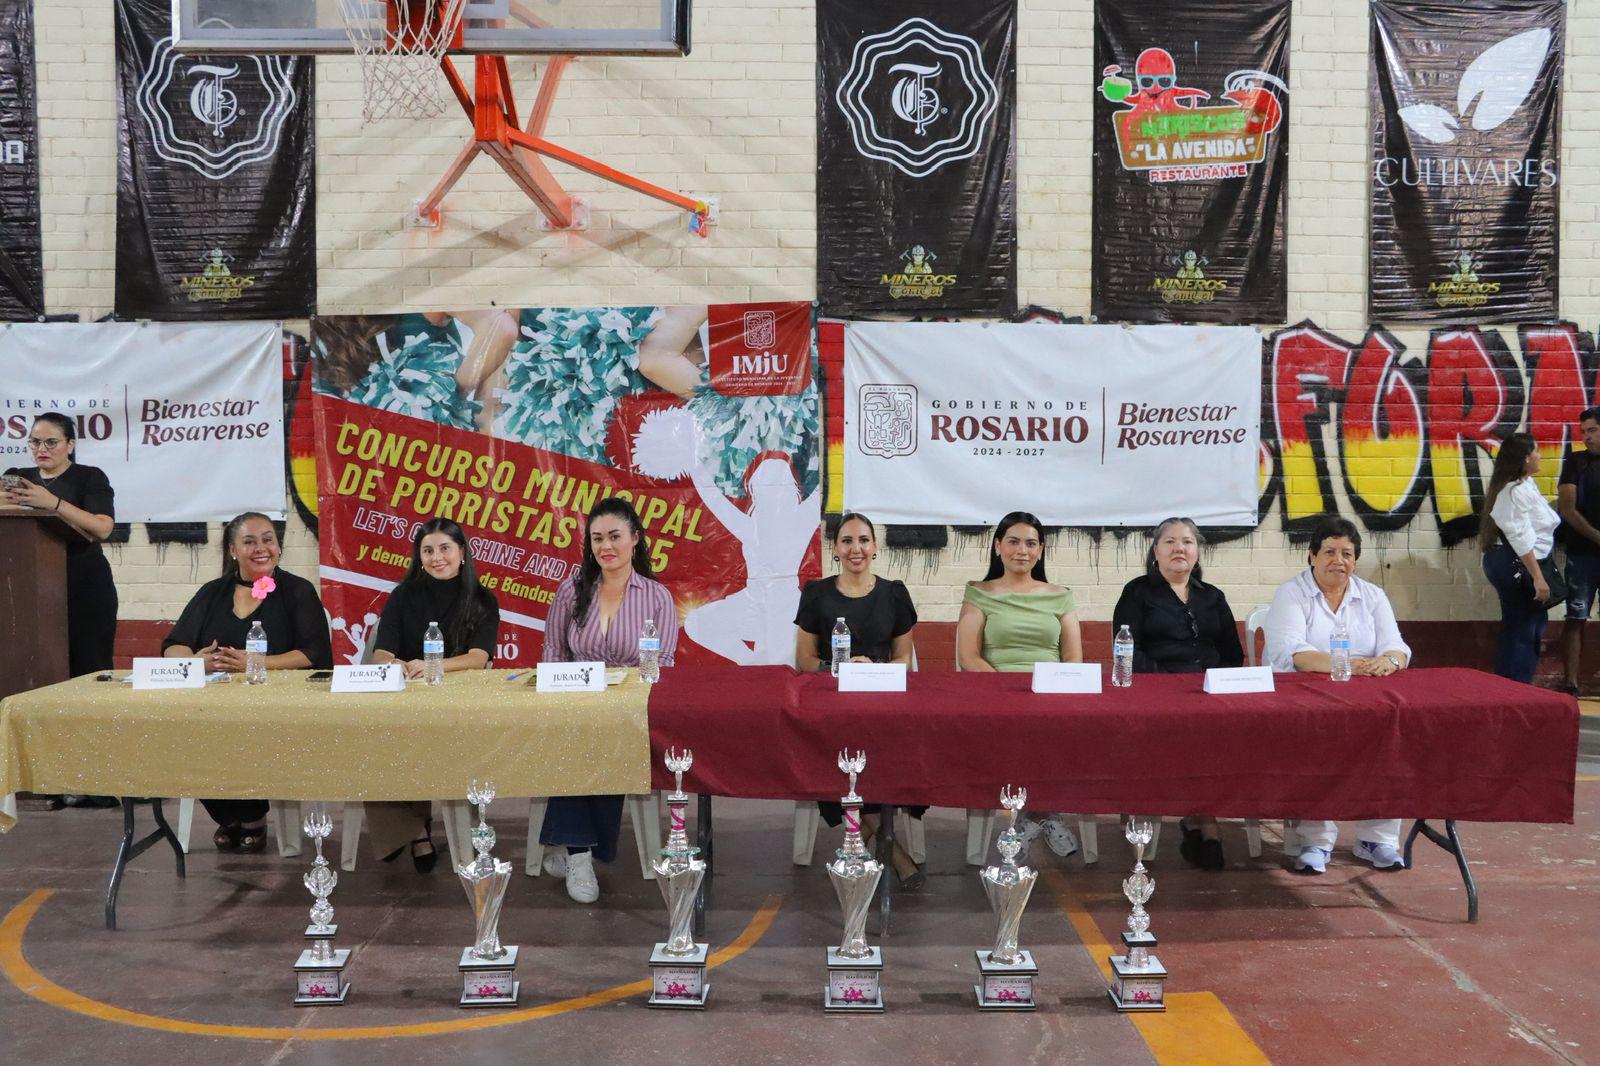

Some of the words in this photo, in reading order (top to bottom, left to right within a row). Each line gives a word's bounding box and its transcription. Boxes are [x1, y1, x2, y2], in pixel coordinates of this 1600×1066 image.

[0, 140, 24, 164] A
[1150, 164, 1248, 182] RESTAURANTE
[1376, 157, 1557, 188] CULTIVARES
[880, 273, 957, 286] MINEROS
[1152, 277, 1228, 290] MINEROS
[1427, 281, 1501, 294] MINEROS
[6, 399, 76, 408] IERNO
[89, 399, 110, 408] DE
[141, 398, 260, 422] Bienestar
[932, 400, 1053, 410] GOBIERNO
[1066, 401, 1087, 410] DE
[1117, 402, 1237, 425] Bienestar
[142, 422, 270, 446] Rosarense
[931, 414, 1089, 443] ROSARIO
[1117, 427, 1246, 450] Rosarense
[336, 422, 516, 493] CONCURSO
[973, 447, 1002, 456] 2024
[1016, 448, 1045, 456] 2027
[336, 462, 385, 502] DE
[390, 475, 578, 549] PORRISTAS
[353, 507, 408, 539] LET'S
[469, 536, 525, 570] SHINE
[523, 553, 568, 581] AND
[356, 544, 369, 561] y
[479, 572, 498, 589] de
[504, 633, 518, 641] DE
